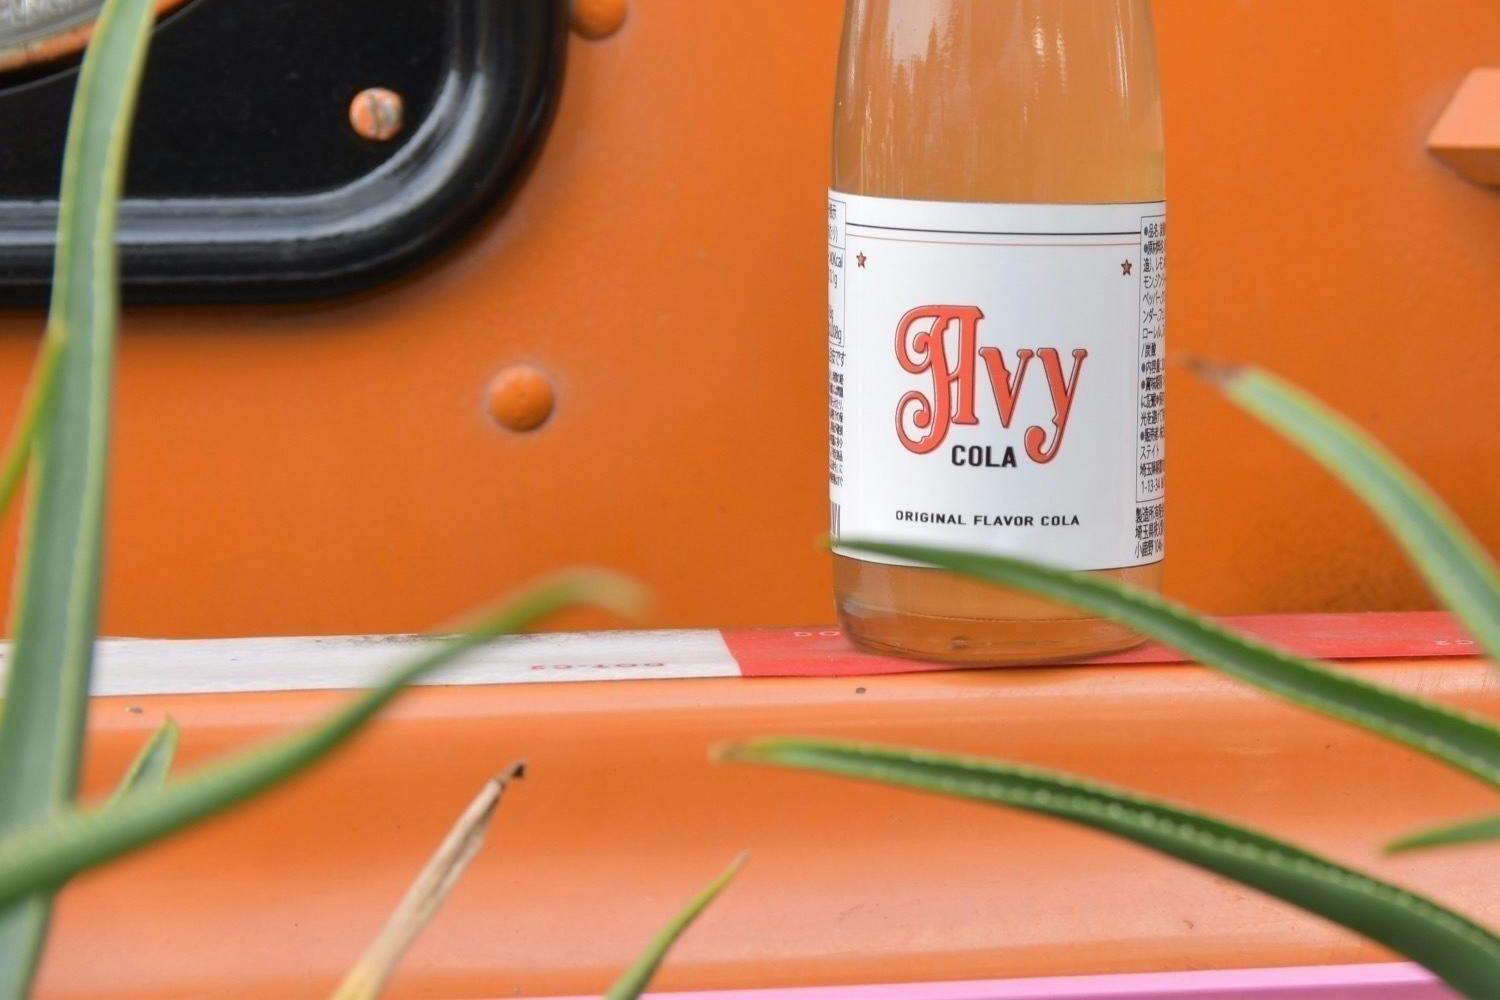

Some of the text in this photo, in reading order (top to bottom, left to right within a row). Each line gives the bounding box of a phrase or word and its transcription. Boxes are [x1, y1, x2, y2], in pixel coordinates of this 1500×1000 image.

[951, 445, 1018, 468] COLA
[895, 510, 1080, 527] ORIGINAL FLAVOR COLA
